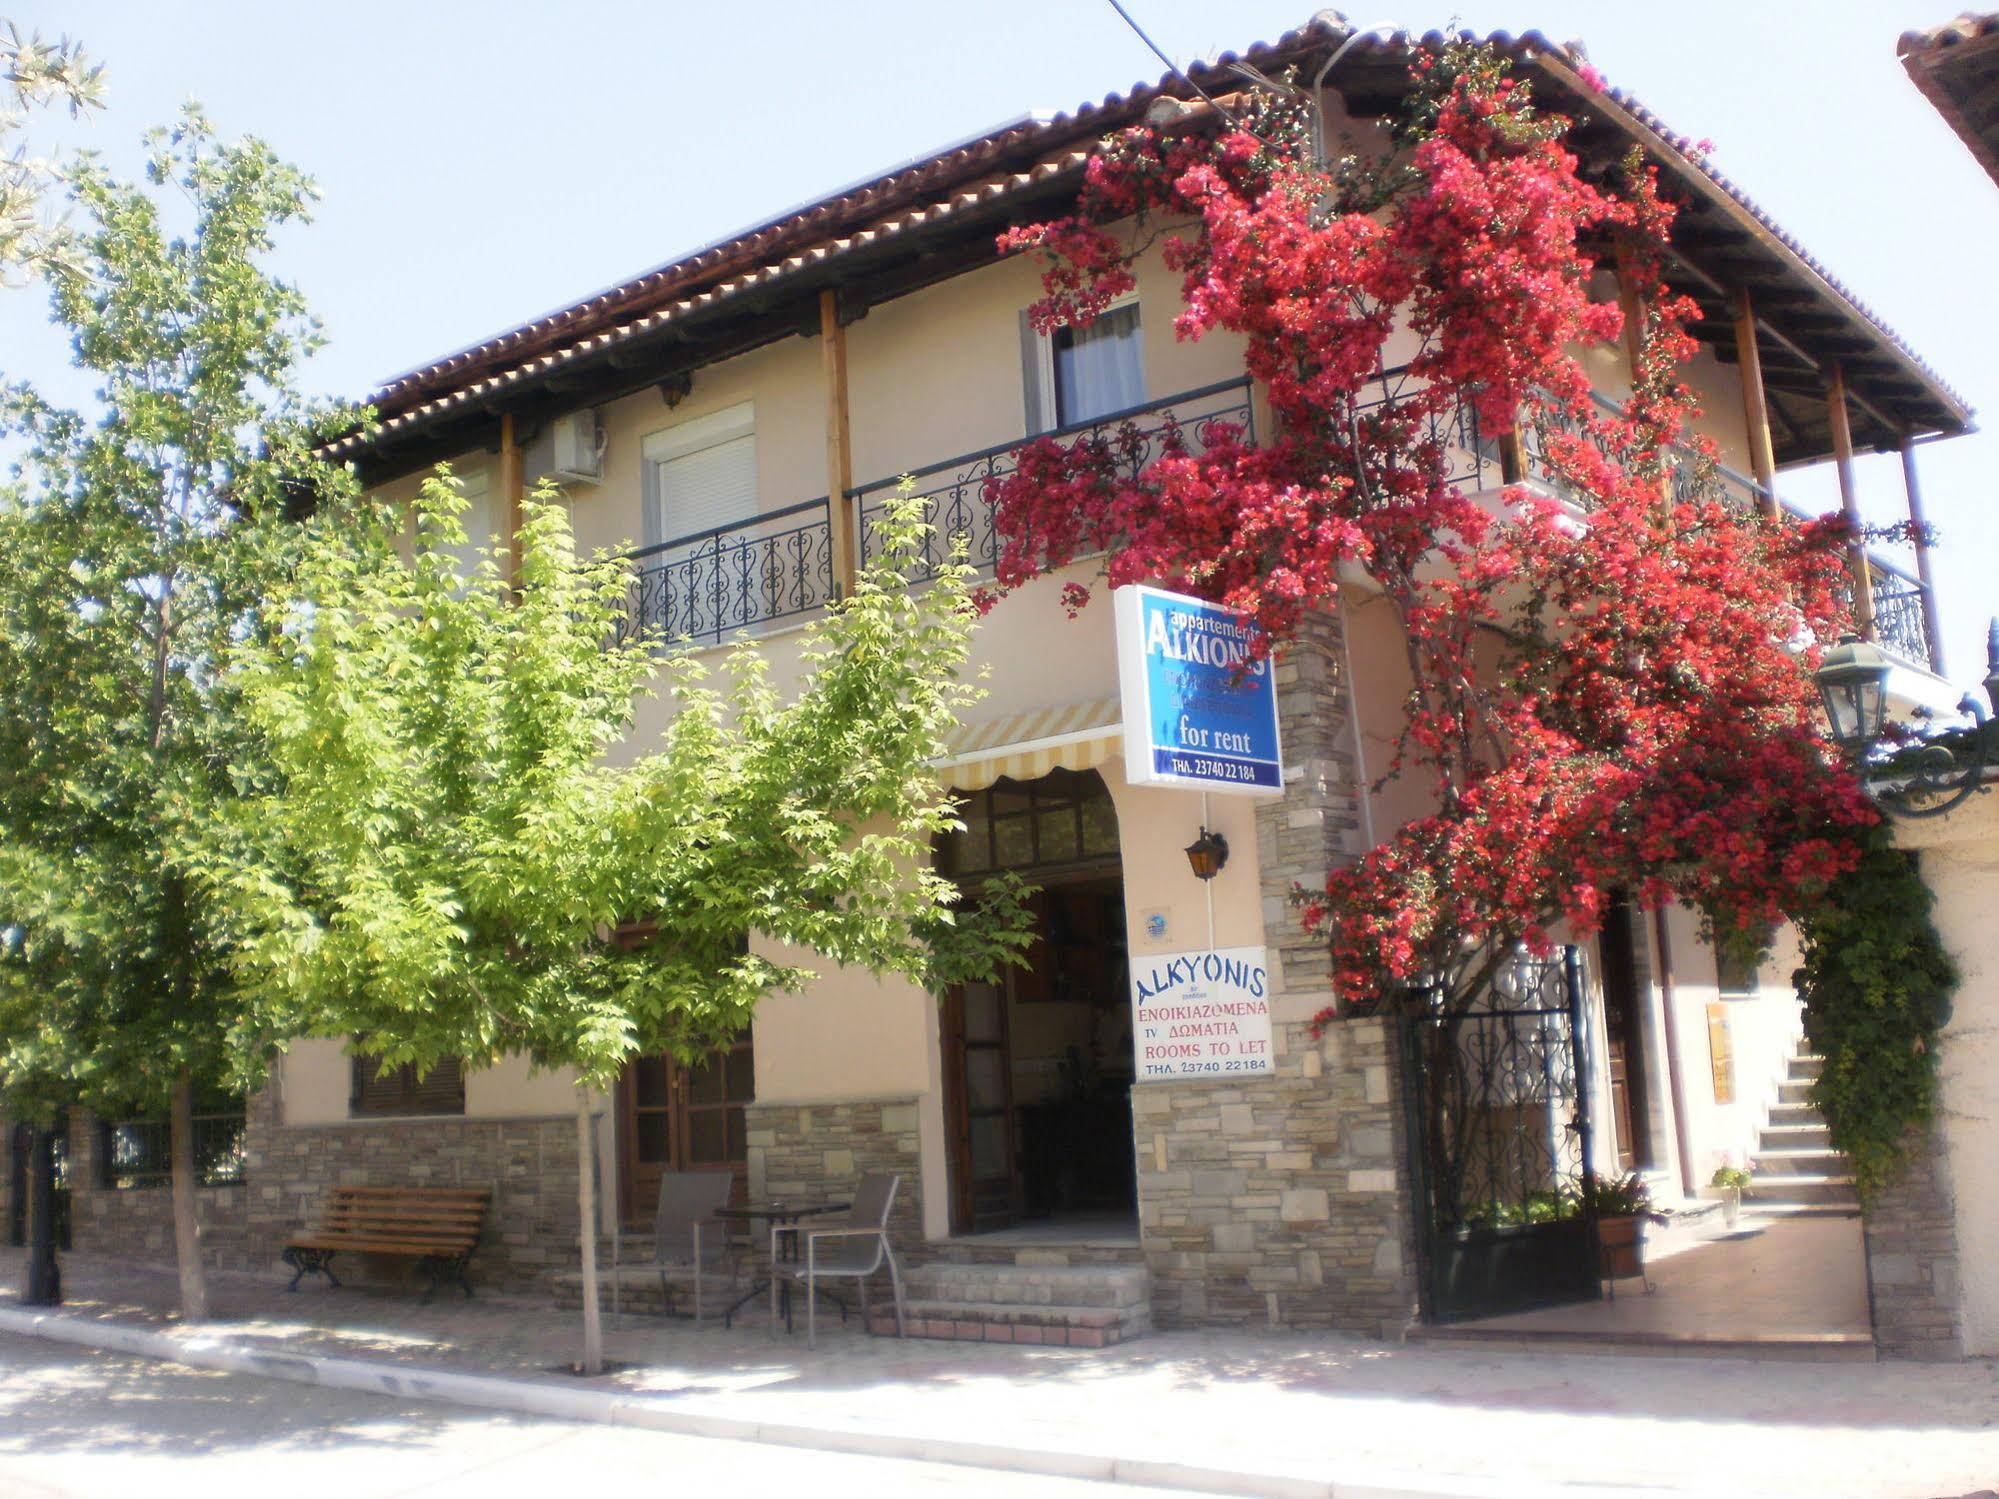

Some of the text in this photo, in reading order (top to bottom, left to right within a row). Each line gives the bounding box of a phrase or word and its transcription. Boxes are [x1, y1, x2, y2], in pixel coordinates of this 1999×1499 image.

[1180, 714, 1251, 754] for rent
[1171, 758, 1193, 773] ΤΗΛ.
[1195, 759, 1224, 777] 23740
[1136, 953, 1266, 1006] ALKYONIS
[1139, 1001, 1268, 1022] ΕΝΟΙΚΙΑΖΟΜΕΝΑ
[1169, 1021, 1239, 1039] ΔΩΜΑΤΙΑ
[1145, 1040, 1267, 1059] ROOMS TO LET
[1146, 1059, 1266, 1075] ΤΗΛ. 23740 22184
